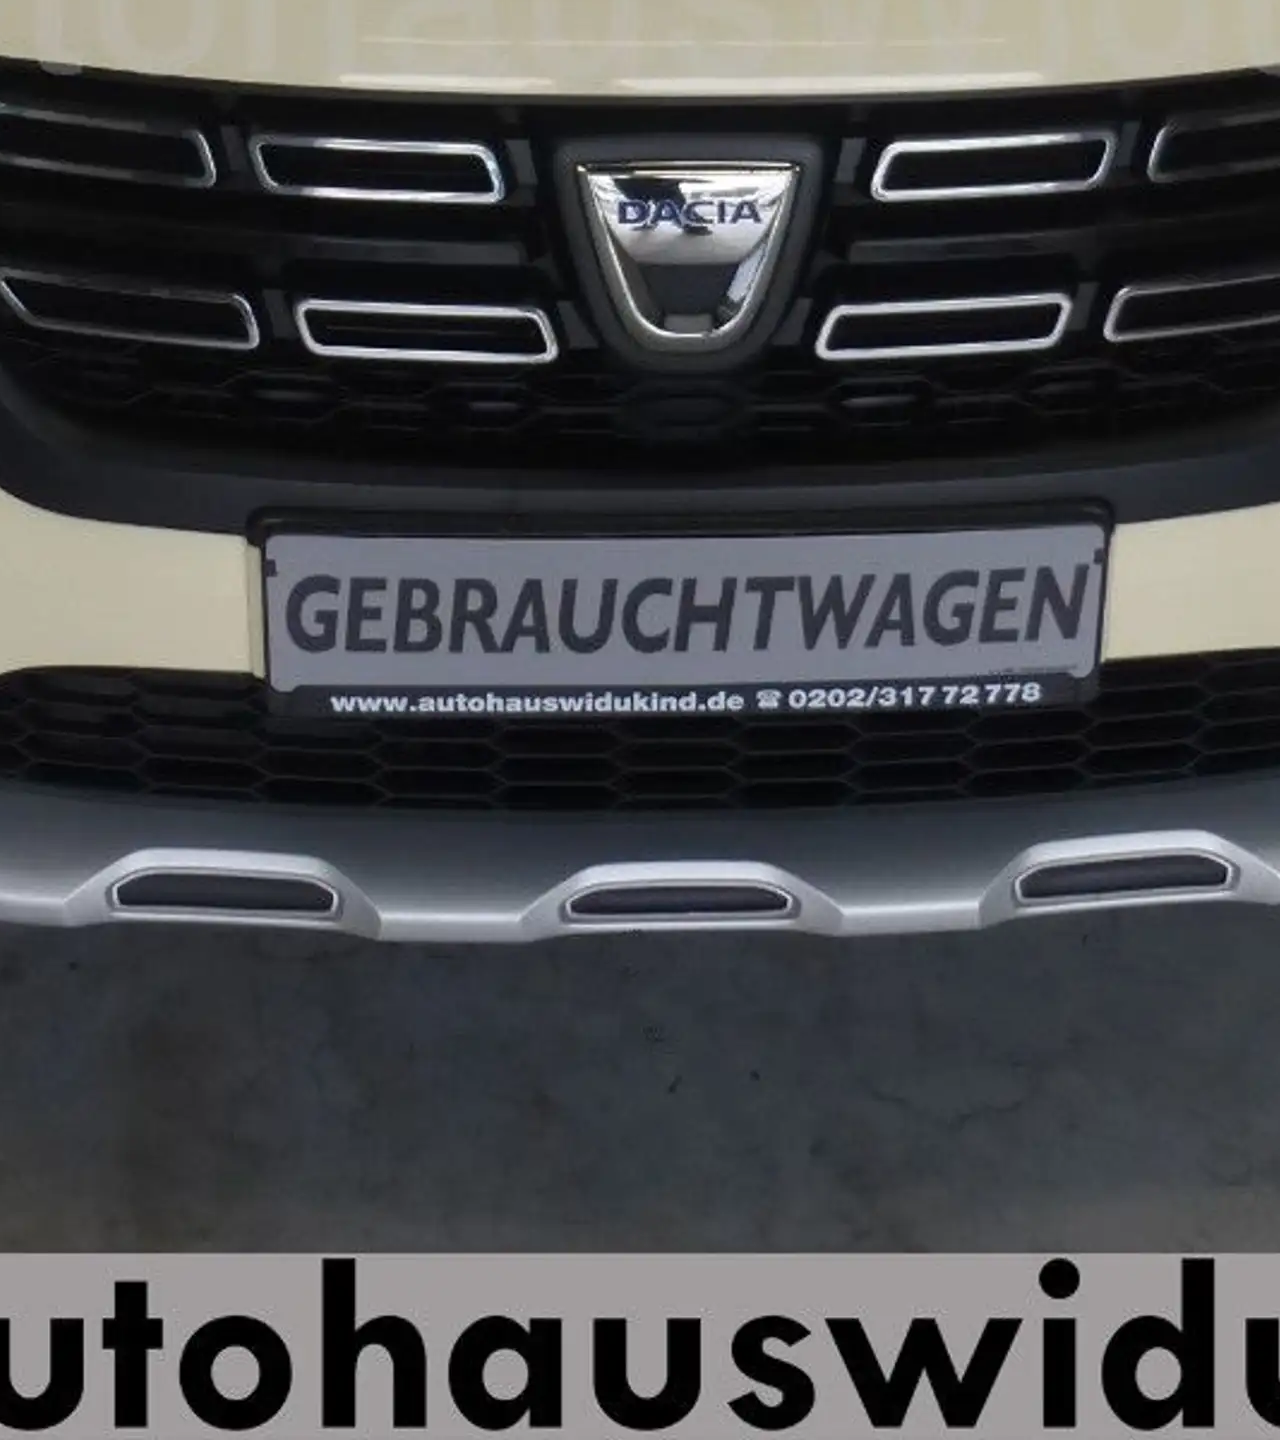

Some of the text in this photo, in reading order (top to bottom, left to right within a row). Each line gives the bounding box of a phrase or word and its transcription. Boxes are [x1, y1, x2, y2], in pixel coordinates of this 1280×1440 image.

[617, 200, 762, 225] DACIA
[284, 563, 1091, 653] GEBRAUCHTWAGEN
[330, 690, 745, 712] www.autohauswidukind.de
